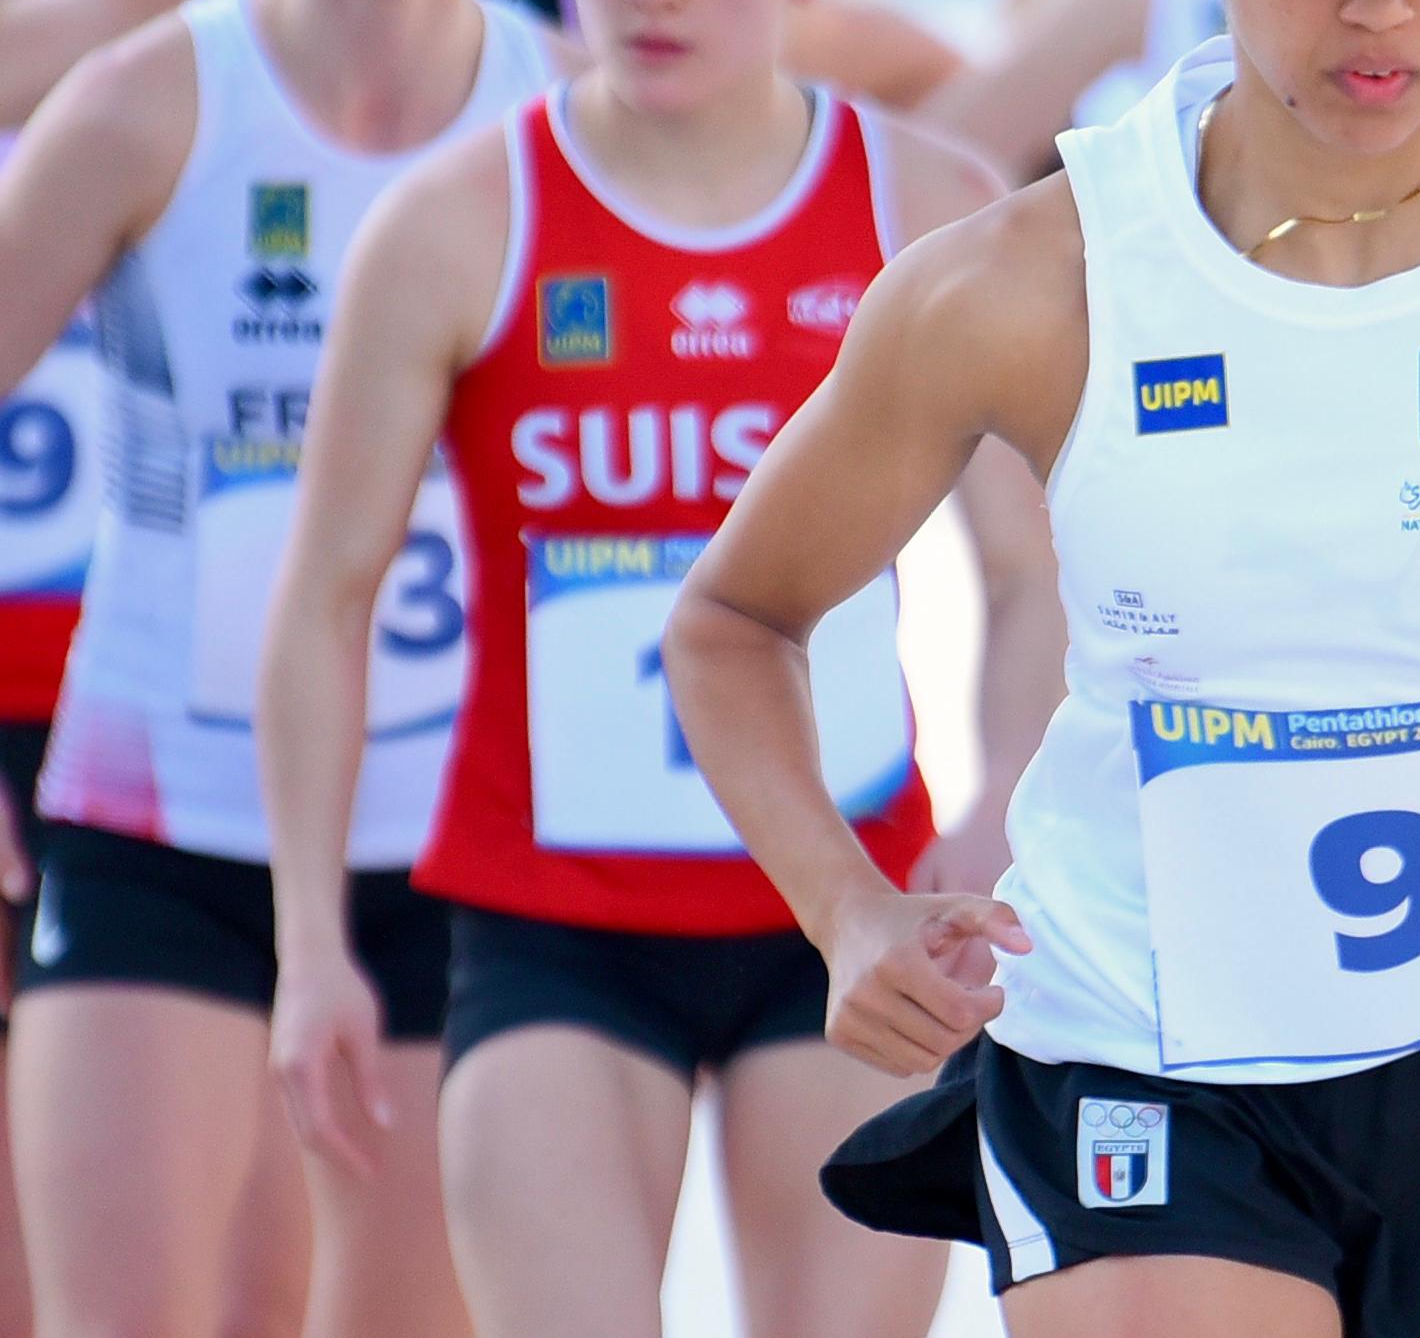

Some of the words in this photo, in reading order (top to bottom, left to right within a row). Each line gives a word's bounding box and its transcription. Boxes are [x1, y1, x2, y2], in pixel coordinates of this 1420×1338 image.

[1141, 377, 1220, 410] UIPM
[545, 534, 653, 576] UIPM
[1151, 703, 1276, 750] UIPM
[1346, 728, 1410, 748] EGYPT
[1097, 1144, 1145, 1152] EGYPTE
